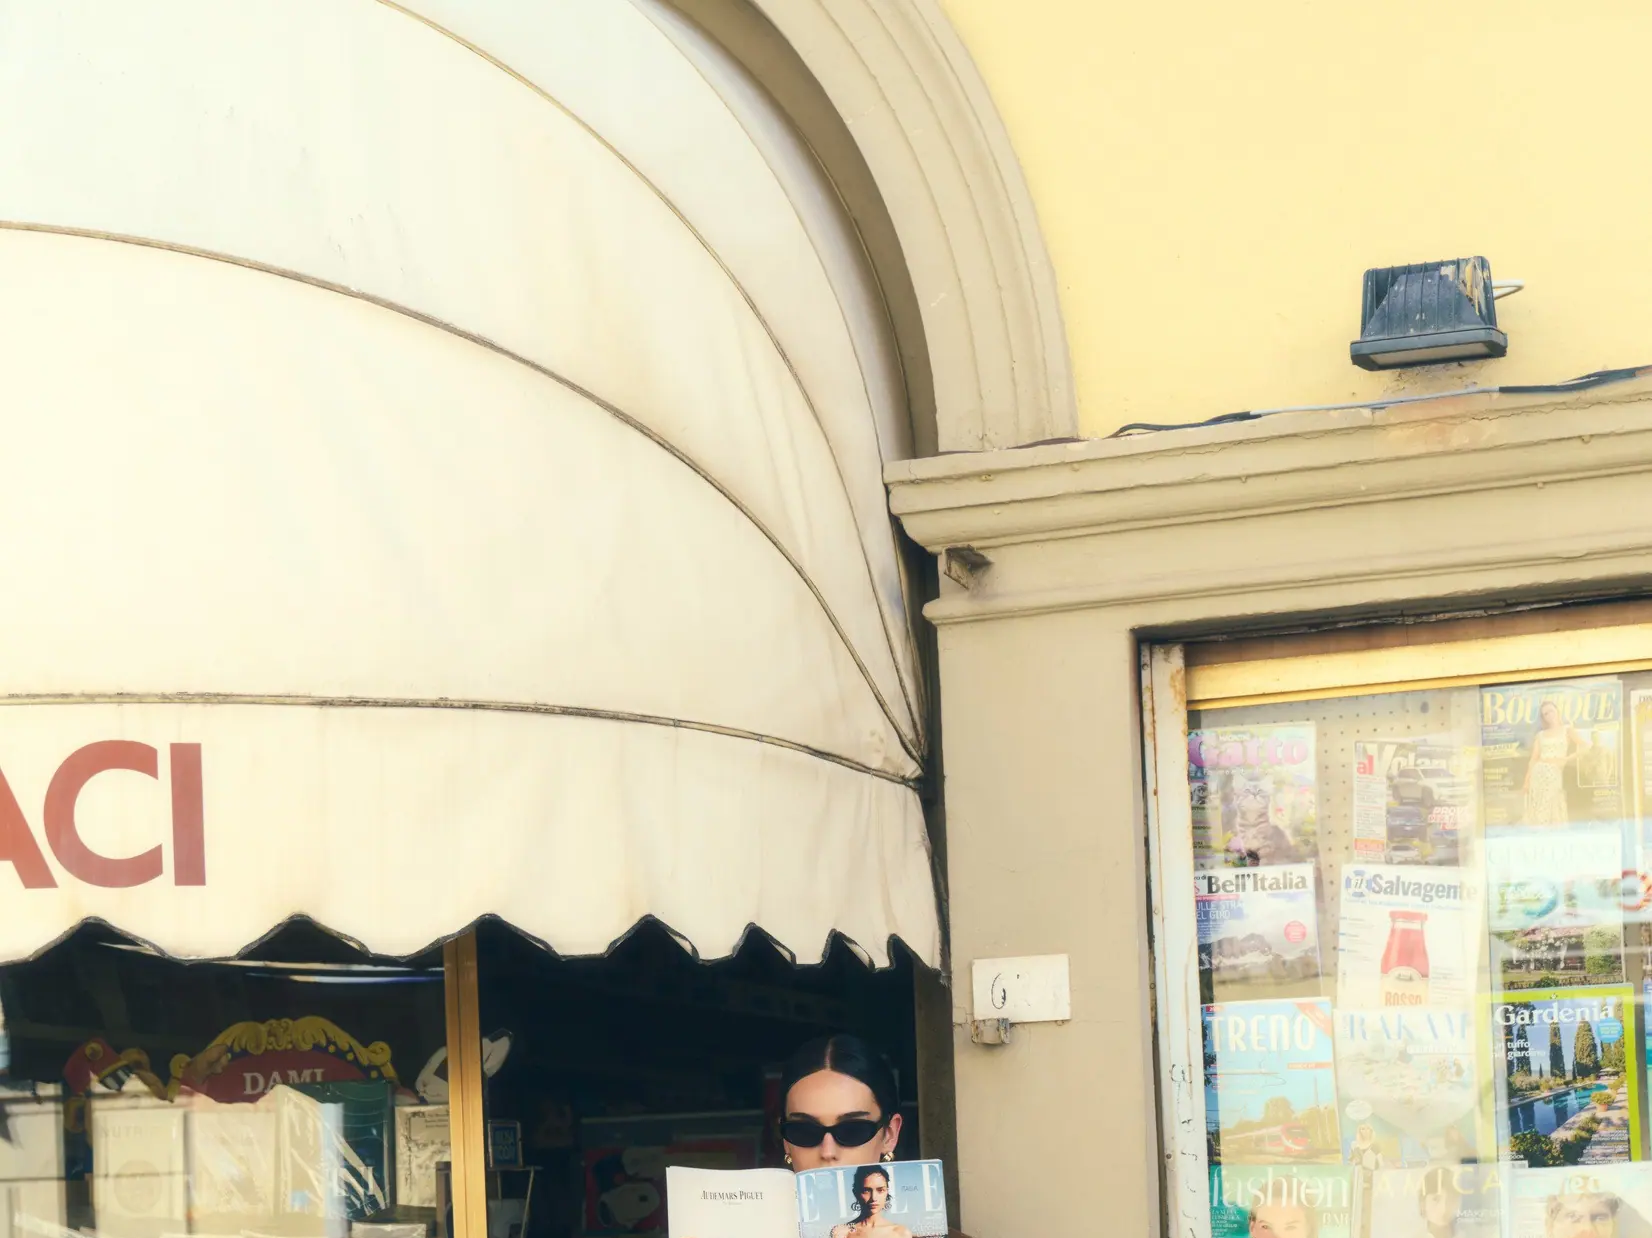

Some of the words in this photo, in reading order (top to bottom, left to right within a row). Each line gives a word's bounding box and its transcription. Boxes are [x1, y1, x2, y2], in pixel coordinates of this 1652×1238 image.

[1188, 733, 1309, 768] Gatto
[1357, 753, 1374, 775] al
[1207, 872, 1308, 894] Bell'Italia
[1371, 873, 1478, 903] Salvagente
[1384, 991, 1422, 1007] ROSSO
[1494, 998, 1615, 1026] Gardenia
[1205, 1013, 1317, 1053] TRENO
[1507, 1039, 1531, 1052] tuffo
[700, 1190, 738, 1200] AUDEMARS
[739, 1190, 763, 1200] PIGUET
[799, 1163, 943, 1223] ELLE
[1211, 1166, 1349, 1208] fashion
[1374, 1167, 1504, 1200] AMICA
